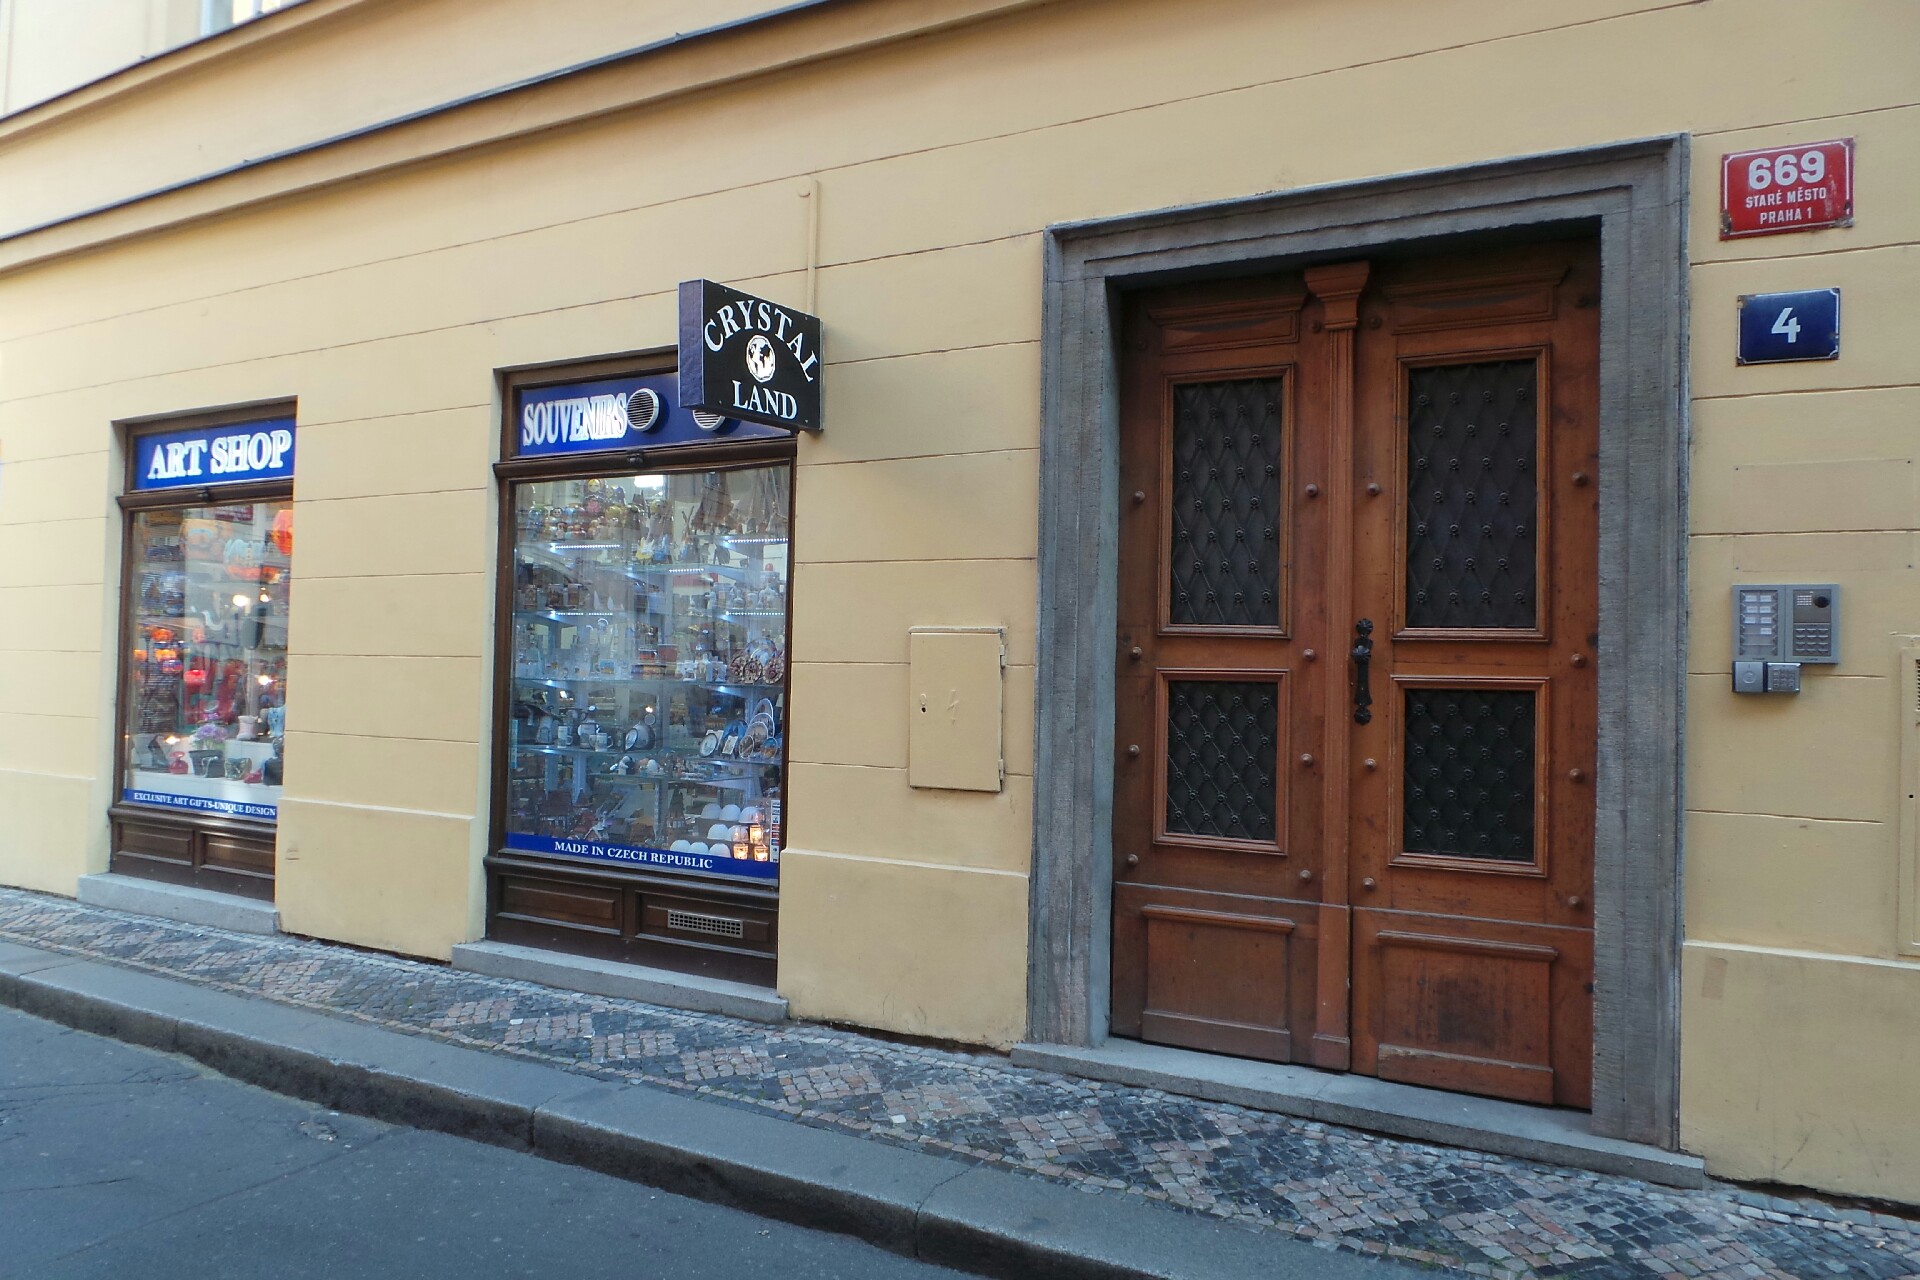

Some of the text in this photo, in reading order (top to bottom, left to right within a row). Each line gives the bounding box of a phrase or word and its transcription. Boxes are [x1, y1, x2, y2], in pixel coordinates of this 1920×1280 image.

[1749, 150, 1825, 190] 669
[1745, 186, 1827, 209] STARÉ MĚSTO
[1760, 206, 1812, 225] PRAHA 1
[704, 300, 818, 383] CRYSTAL
[1771, 307, 1801, 343] 4
[732, 380, 798, 420] LAND
[523, 392, 628, 447] SOUVENIRS
[147, 429, 292, 480] ART SHOP
[134, 792, 172, 804] EXCLUSIVE
[173, 796, 188, 806] ART
[245, 804, 276, 816] DESIGN
[554, 841, 714, 869] MADE IN CZECH REPUBLIC
